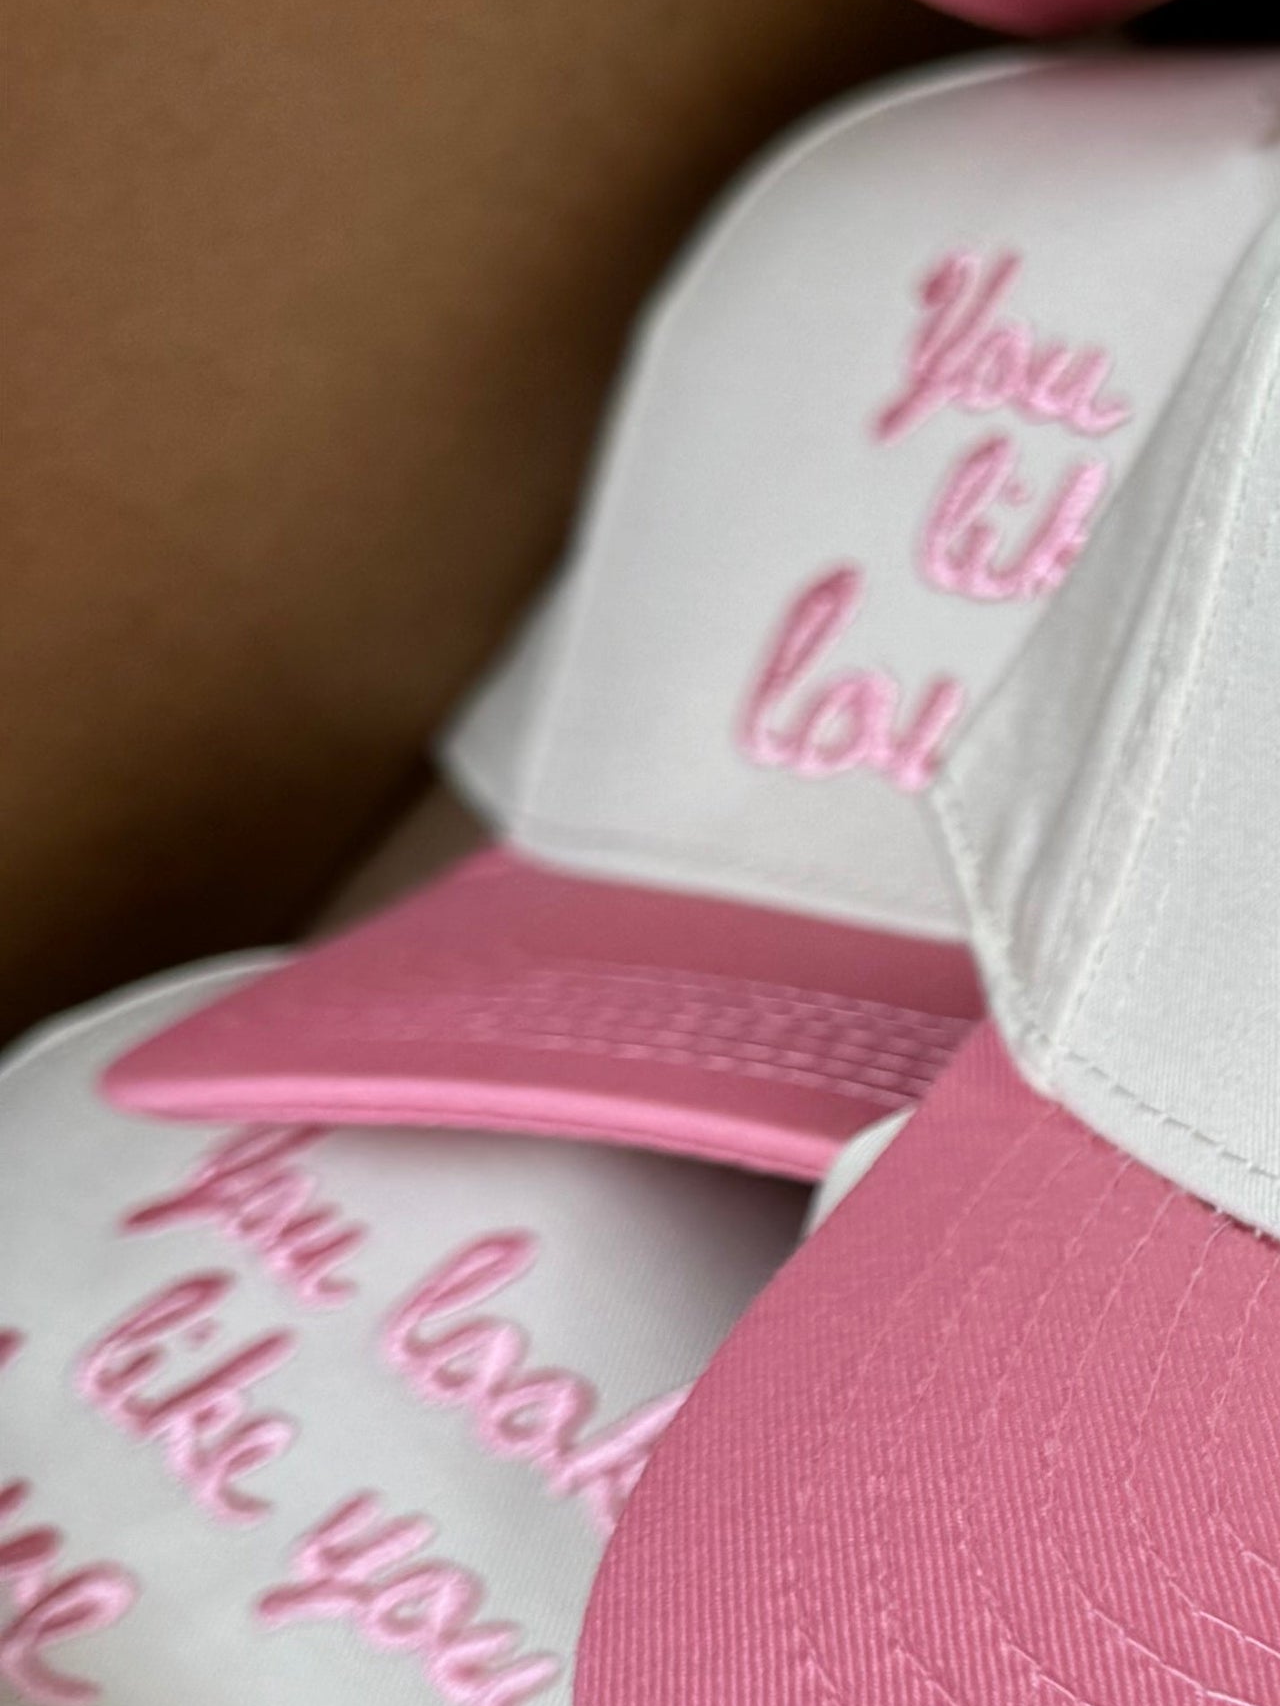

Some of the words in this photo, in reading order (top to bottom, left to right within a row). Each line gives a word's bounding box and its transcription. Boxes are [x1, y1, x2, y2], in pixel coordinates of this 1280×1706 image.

[868, 251, 1135, 444] You
[914, 432, 1110, 602] lik
[78, 1268, 297, 1526] like
